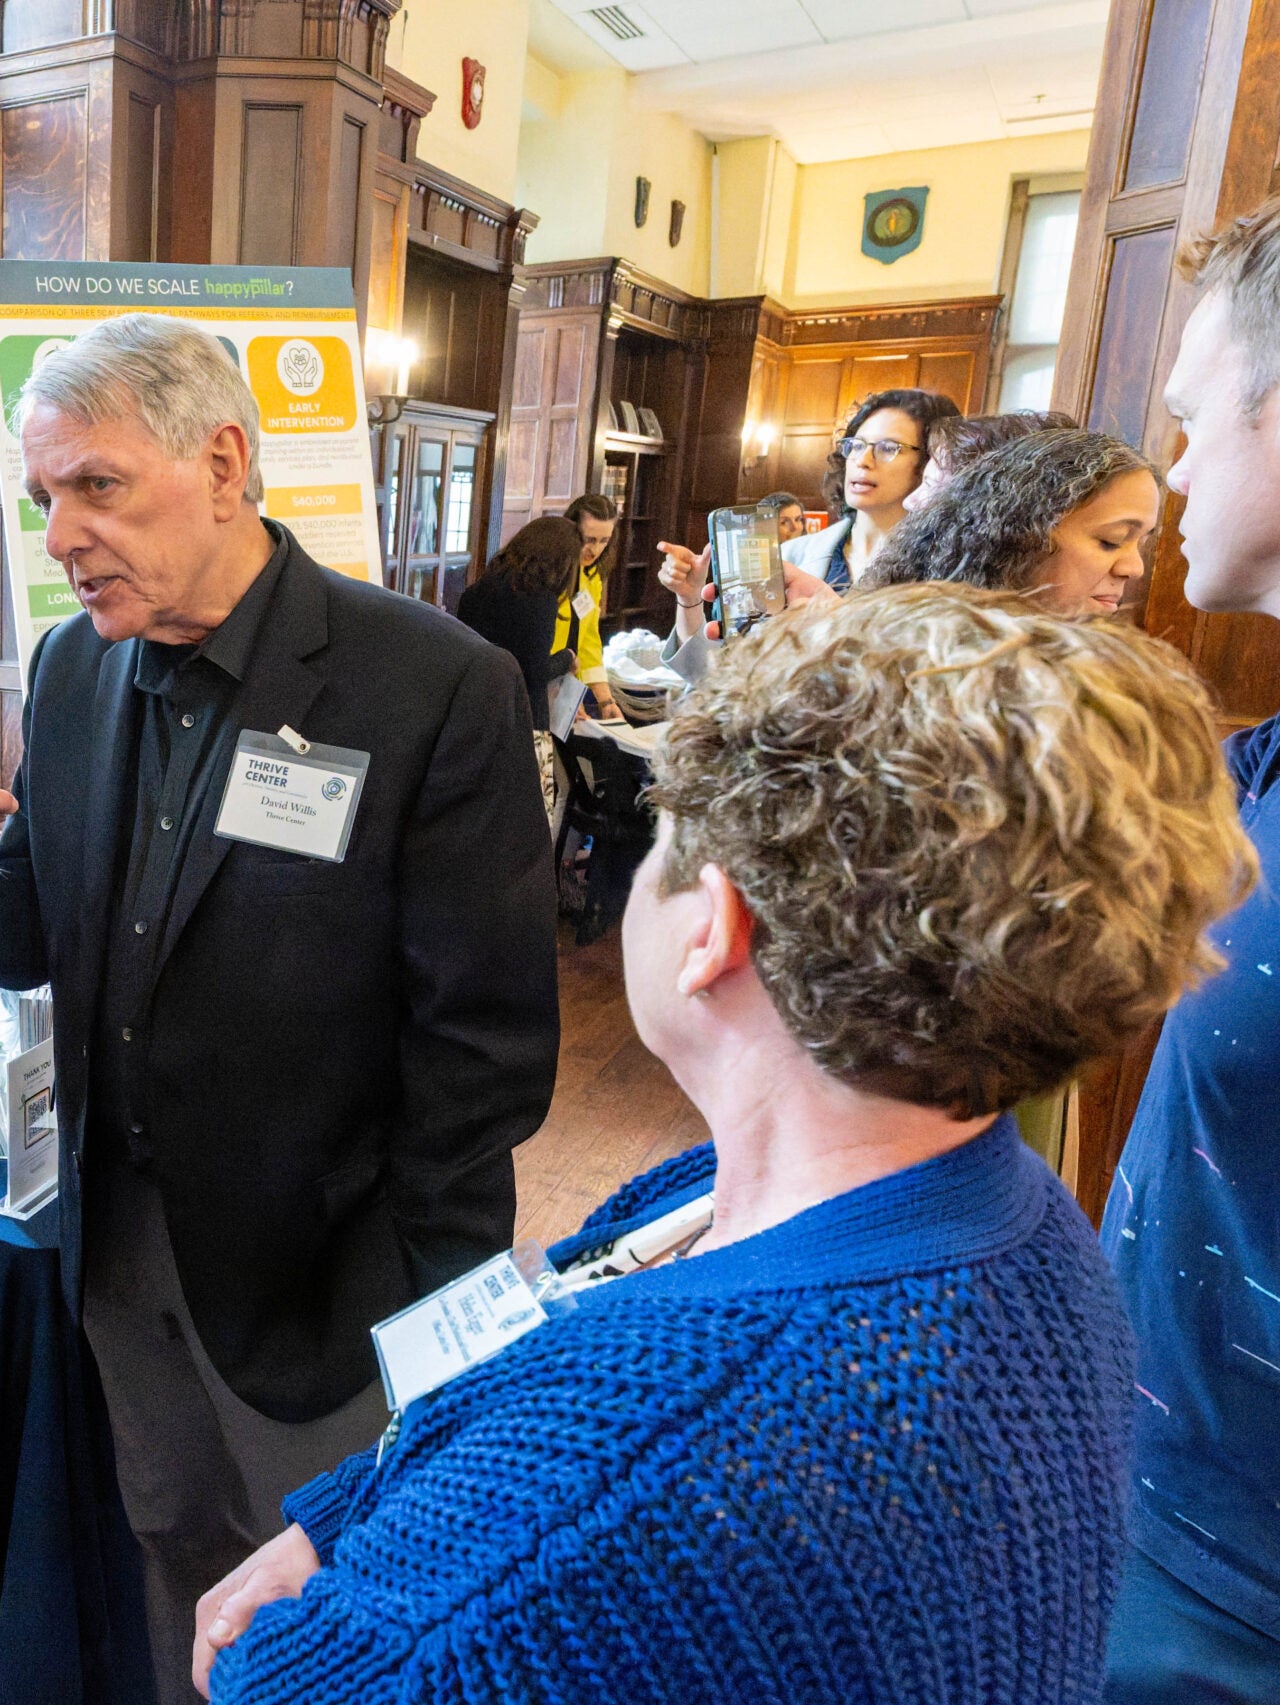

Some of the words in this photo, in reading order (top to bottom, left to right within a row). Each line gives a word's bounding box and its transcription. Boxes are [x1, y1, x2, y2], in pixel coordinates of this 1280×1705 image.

[35, 276, 81, 293] HOW
[86, 277, 112, 294] DO
[115, 278, 145, 294] WE
[147, 279, 200, 295] SCALE
[0, 308, 55, 317] COMPARISON
[57, 308, 67, 317] OF
[71, 308, 96, 317] THREE
[179, 310, 221, 318] PATHWAYS
[275, 311, 291, 319] AND
[288, 402, 321, 414] EARLY
[267, 416, 344, 428] INTERVENTION
[249, 760, 289, 776] THRIVE
[245, 771, 288, 788] CENTER
[261, 796, 289, 811] David
[290, 802, 317, 817] Willis
[285, 815, 306, 827] Center
[23, 1068, 40, 1081] THANK
[483, 1274, 505, 1300] CENTER
